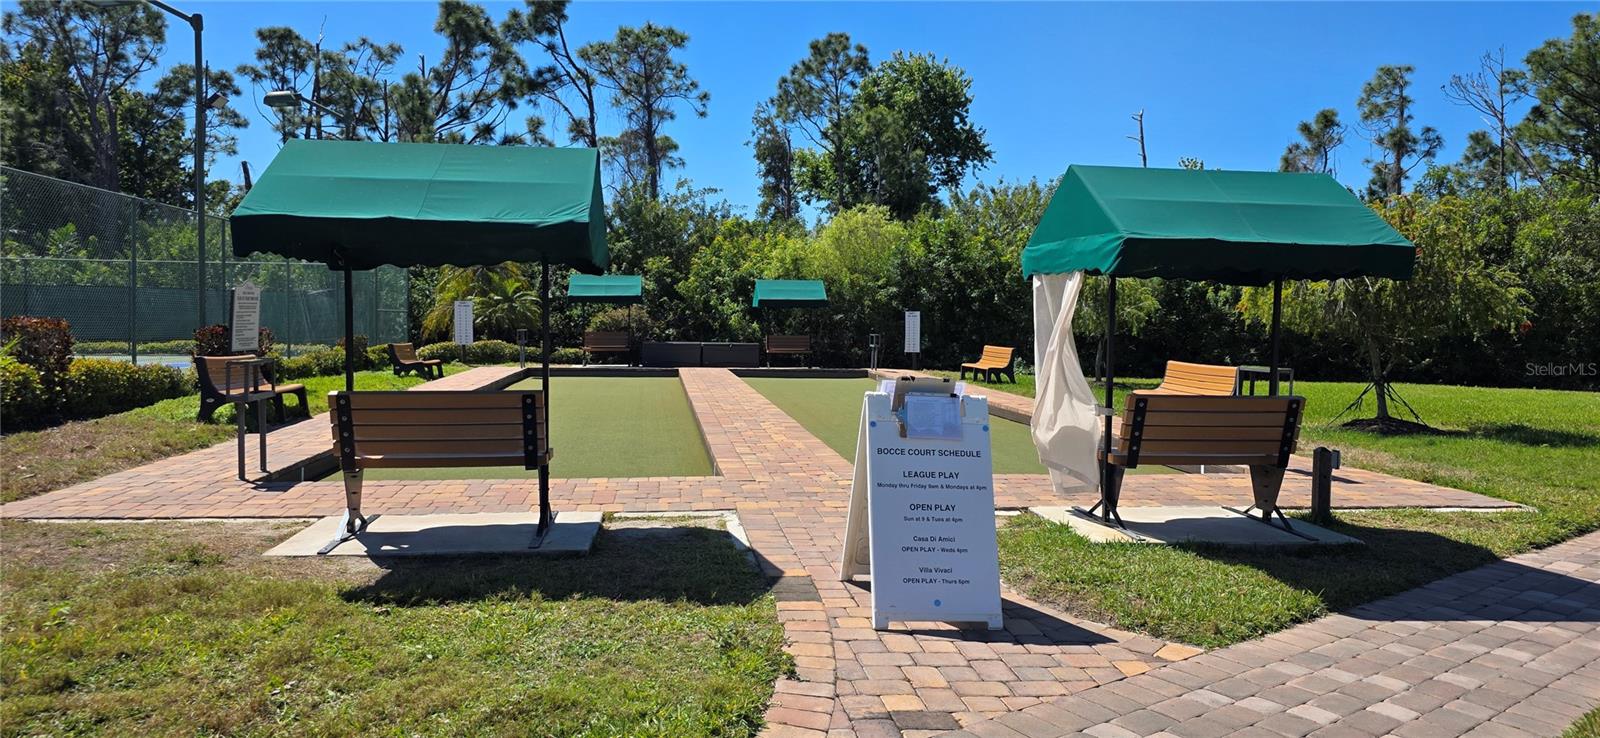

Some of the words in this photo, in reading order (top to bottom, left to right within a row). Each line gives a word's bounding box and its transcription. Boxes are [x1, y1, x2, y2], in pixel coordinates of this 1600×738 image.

[877, 447, 906, 456] BOCCE
[907, 448, 936, 457] COURT
[938, 449, 981, 458] SCHEDULE
[902, 470, 936, 479] LEAGUE
[938, 471, 960, 480] PLAY
[909, 503, 933, 511] OPEN
[934, 504, 956, 512] PLAY
